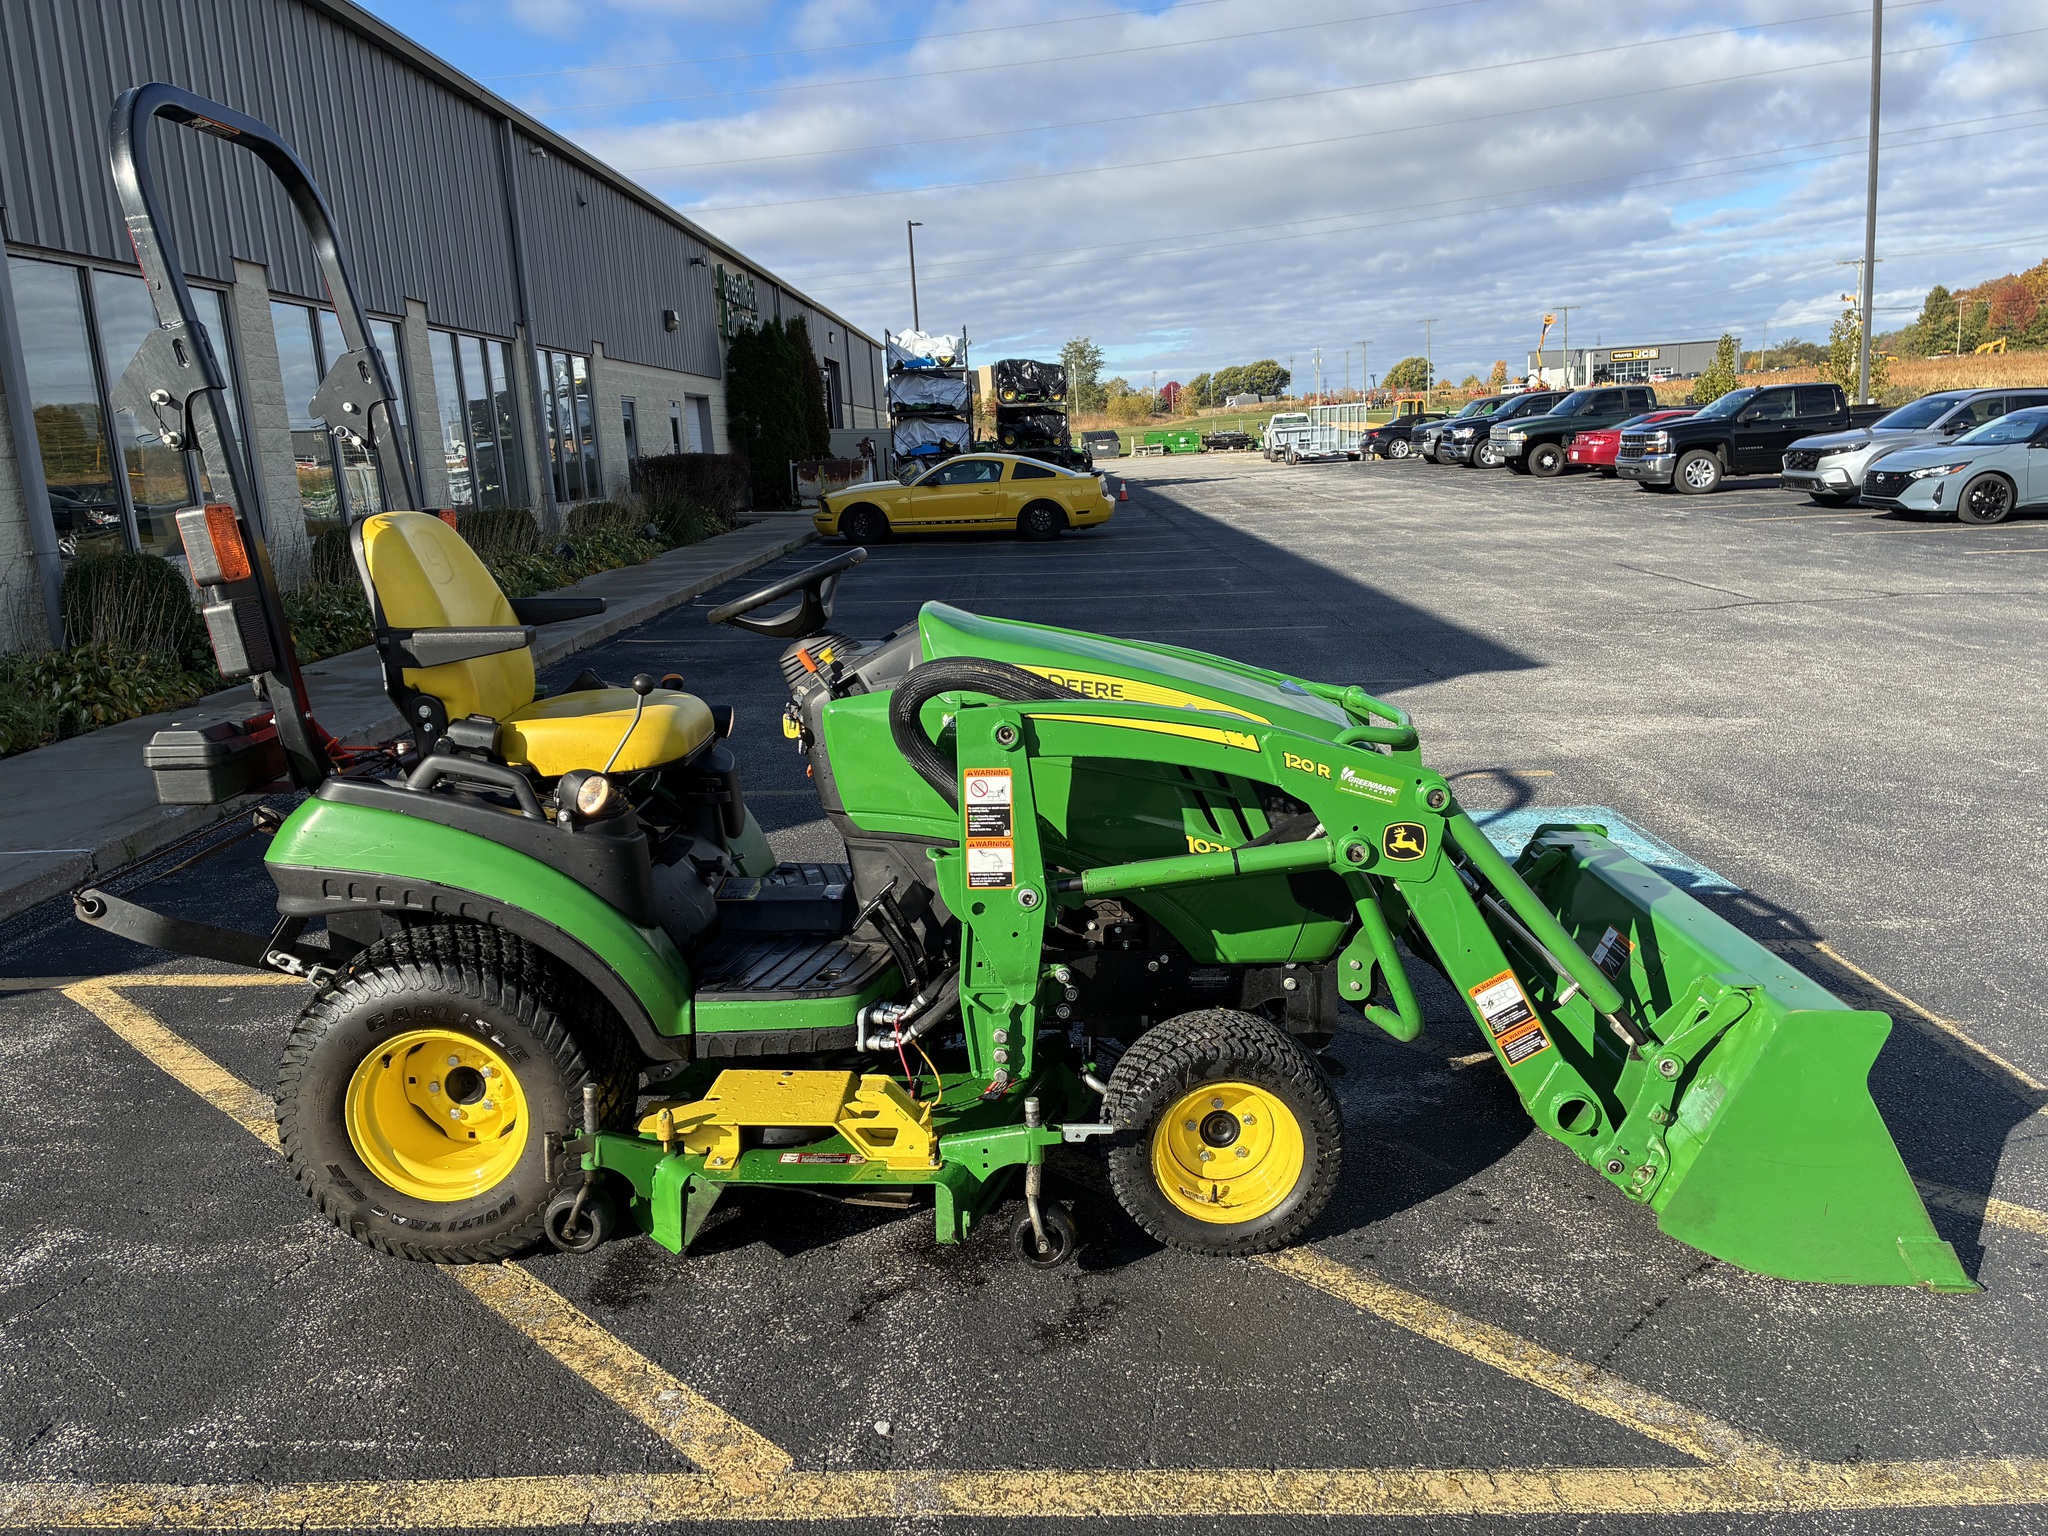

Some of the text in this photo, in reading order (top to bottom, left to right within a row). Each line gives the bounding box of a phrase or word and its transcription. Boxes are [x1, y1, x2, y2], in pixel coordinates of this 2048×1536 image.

[1635, 350, 1656, 358] JCB
[1283, 751, 1331, 780] 120 R
[1348, 776, 1399, 795] GREENMARK
[1480, 973, 1508, 990] WARNING
[366, 1006, 531, 1064] CARLISLE
[1509, 1024, 1536, 1040] WARNING
[370, 1204, 442, 1233] TRAC
[448, 1195, 516, 1232] MULTI
